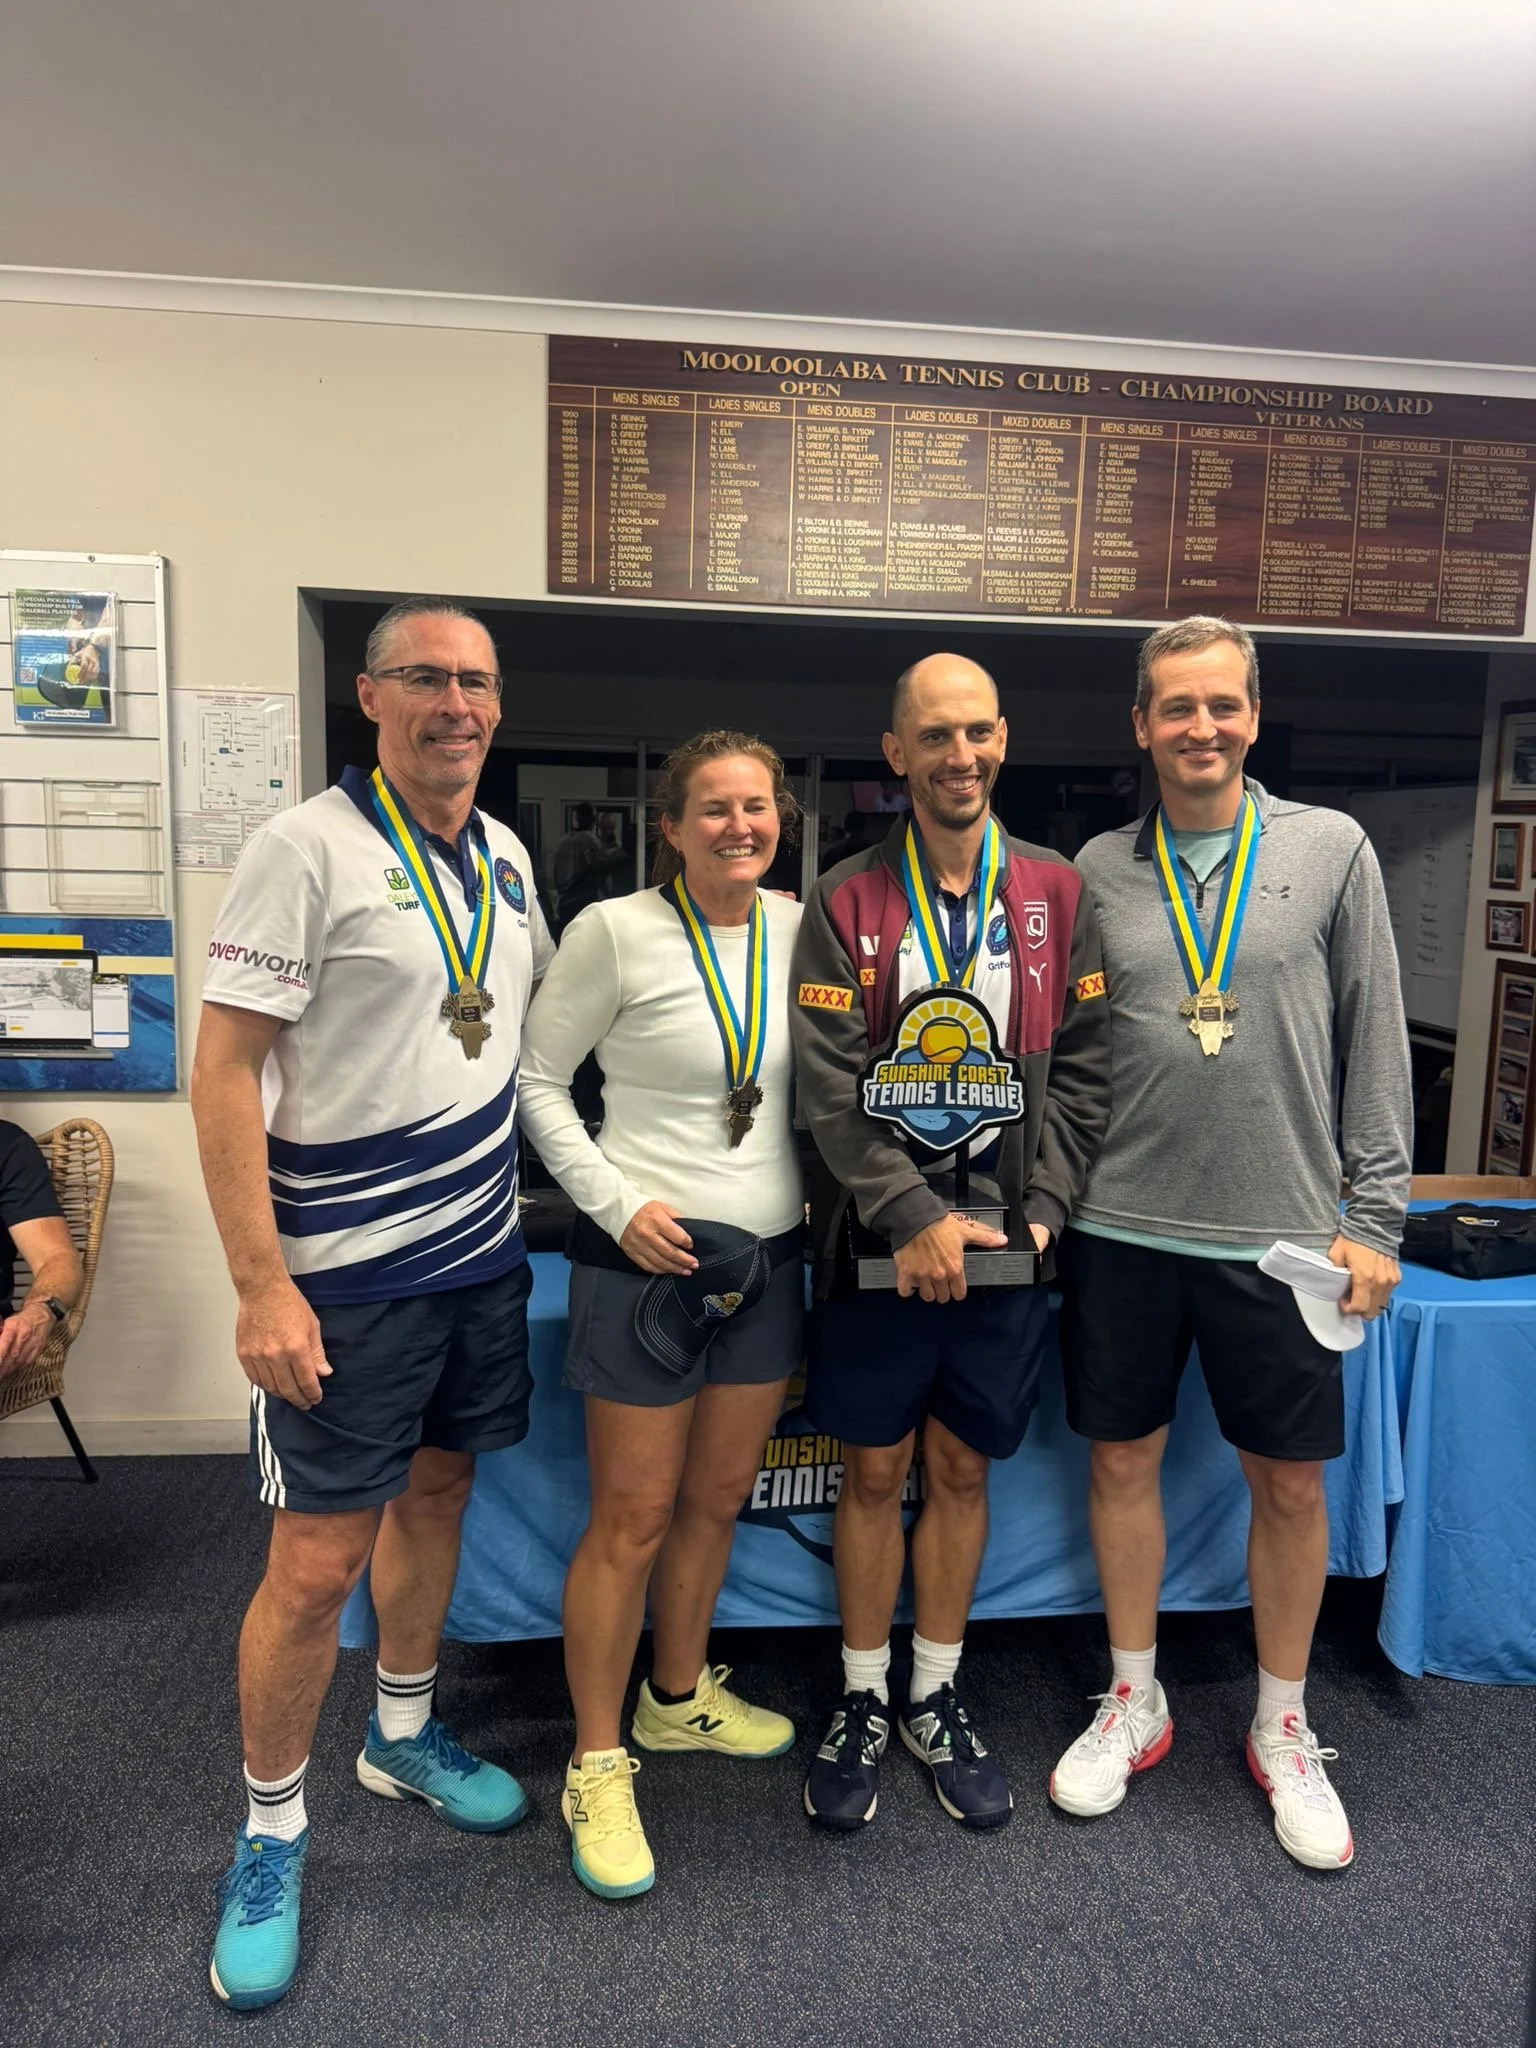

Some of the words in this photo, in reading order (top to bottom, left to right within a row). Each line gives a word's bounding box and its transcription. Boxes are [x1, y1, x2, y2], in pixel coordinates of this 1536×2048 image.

[682, 349, 887, 382] MOOLOOLABA
[900, 363, 1004, 389] TENNIS
[1016, 370, 1091, 394] CLUB
[1120, 378, 1333, 410] CHAMPIONSHIP
[1344, 395, 1434, 417] BOARD
[779, 380, 841, 398] OPEN
[612, 392, 638, 404] MENS
[642, 394, 680, 406] SINGLES
[709, 399, 740, 411] LADIES
[744, 401, 781, 412] SINGLES
[808, 404, 832, 416] MENS
[836, 406, 876, 418] DOUBLES
[905, 410, 935, 422] LADIES
[938, 412, 978, 424] DOUBLES
[1003, 416, 1029, 428] MIXED
[1032, 417, 1071, 430] DOUBLES
[1255, 411, 1365, 431] VETERANS
[1101, 422, 1124, 434] MENS
[1128, 424, 1163, 436] SINGLES
[1191, 427, 1220, 439] LADIES
[1223, 428, 1258, 441] SINGLES
[1109, 443, 1140, 452] WILLIAMS
[1284, 435, 1307, 446] MENS
[1309, 436, 1348, 447] DOUBLES
[1373, 440, 1401, 450] LADIES
[1403, 441, 1441, 453] DOUBLES
[1463, 445, 1488, 456] MIXED
[1490, 446, 1527, 458] DOUBLES
[617, 527, 642, 535] KRONK
[618, 571, 653, 579] DOUGLAS
[387, 893, 418, 903] DALEY
[395, 901, 420, 911] TURF
[801, 986, 848, 1008] XXXX
[878, 1064, 952, 1083] SUNSHINE
[957, 1065, 1008, 1085] COAST
[868, 1082, 937, 1107] TENNIS
[946, 1082, 1019, 1110] LEAGUE
[760, 1435, 843, 1468] UNSHI
[751, 1464, 844, 1510] ENNIS
